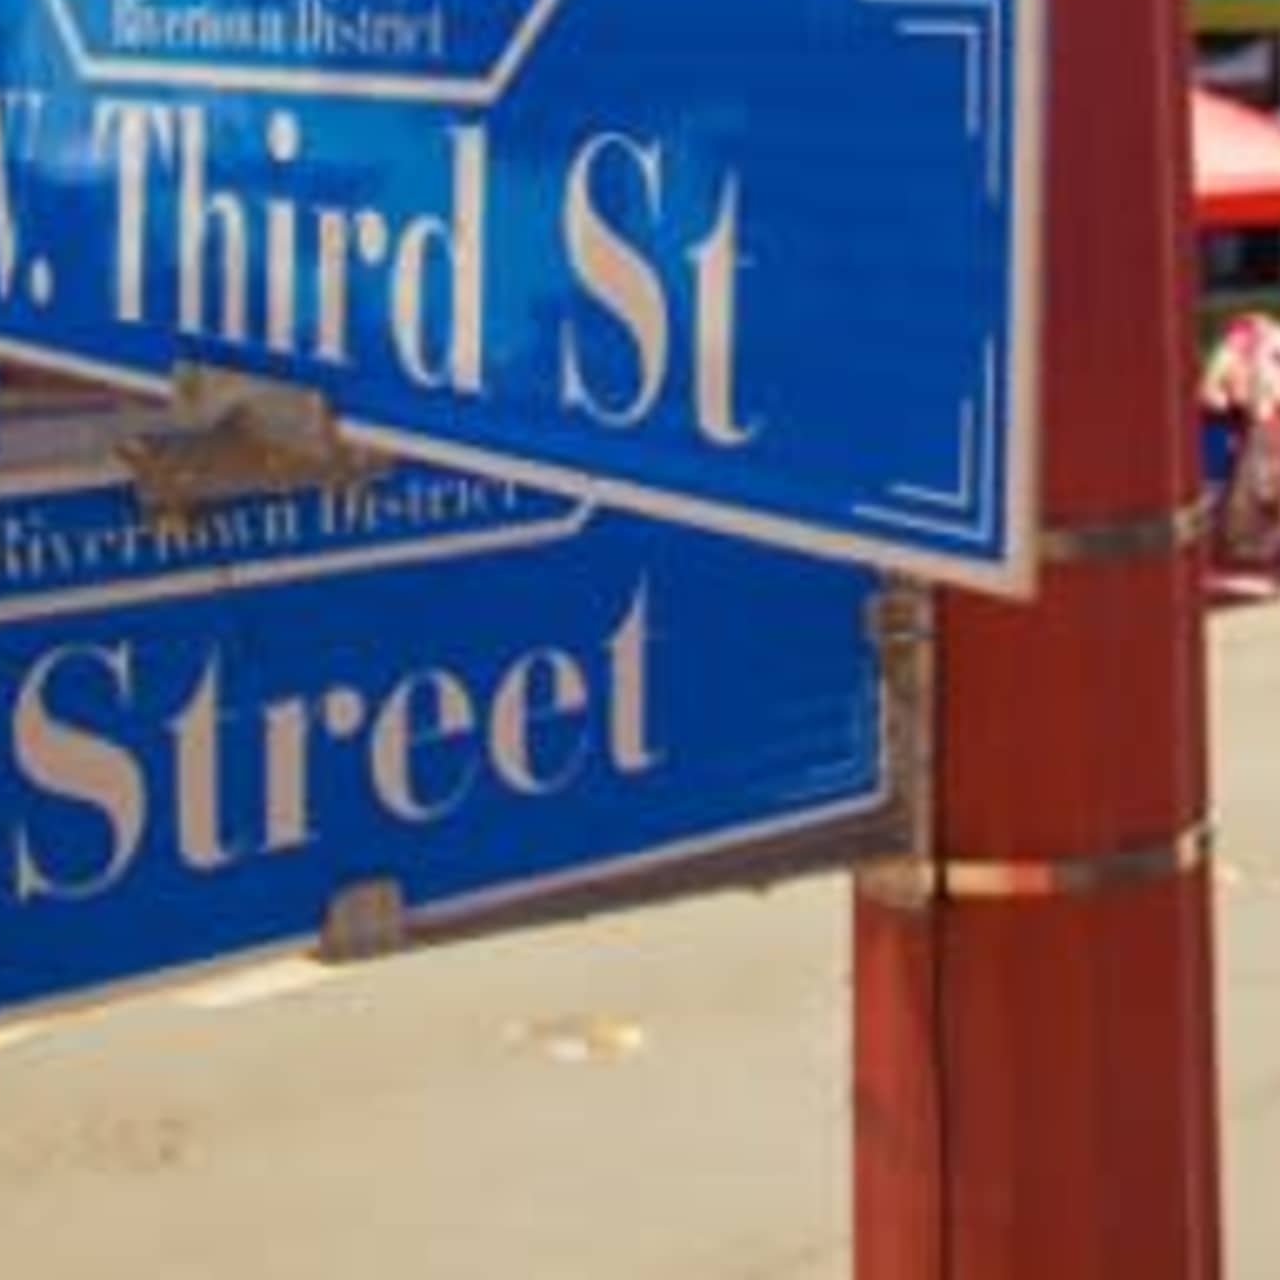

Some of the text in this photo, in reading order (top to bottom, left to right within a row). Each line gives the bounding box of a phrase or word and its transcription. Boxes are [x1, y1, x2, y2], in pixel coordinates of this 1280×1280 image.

[92, 98, 488, 396] Third
[562, 133, 762, 444] St
[12, 568, 668, 902] Street
